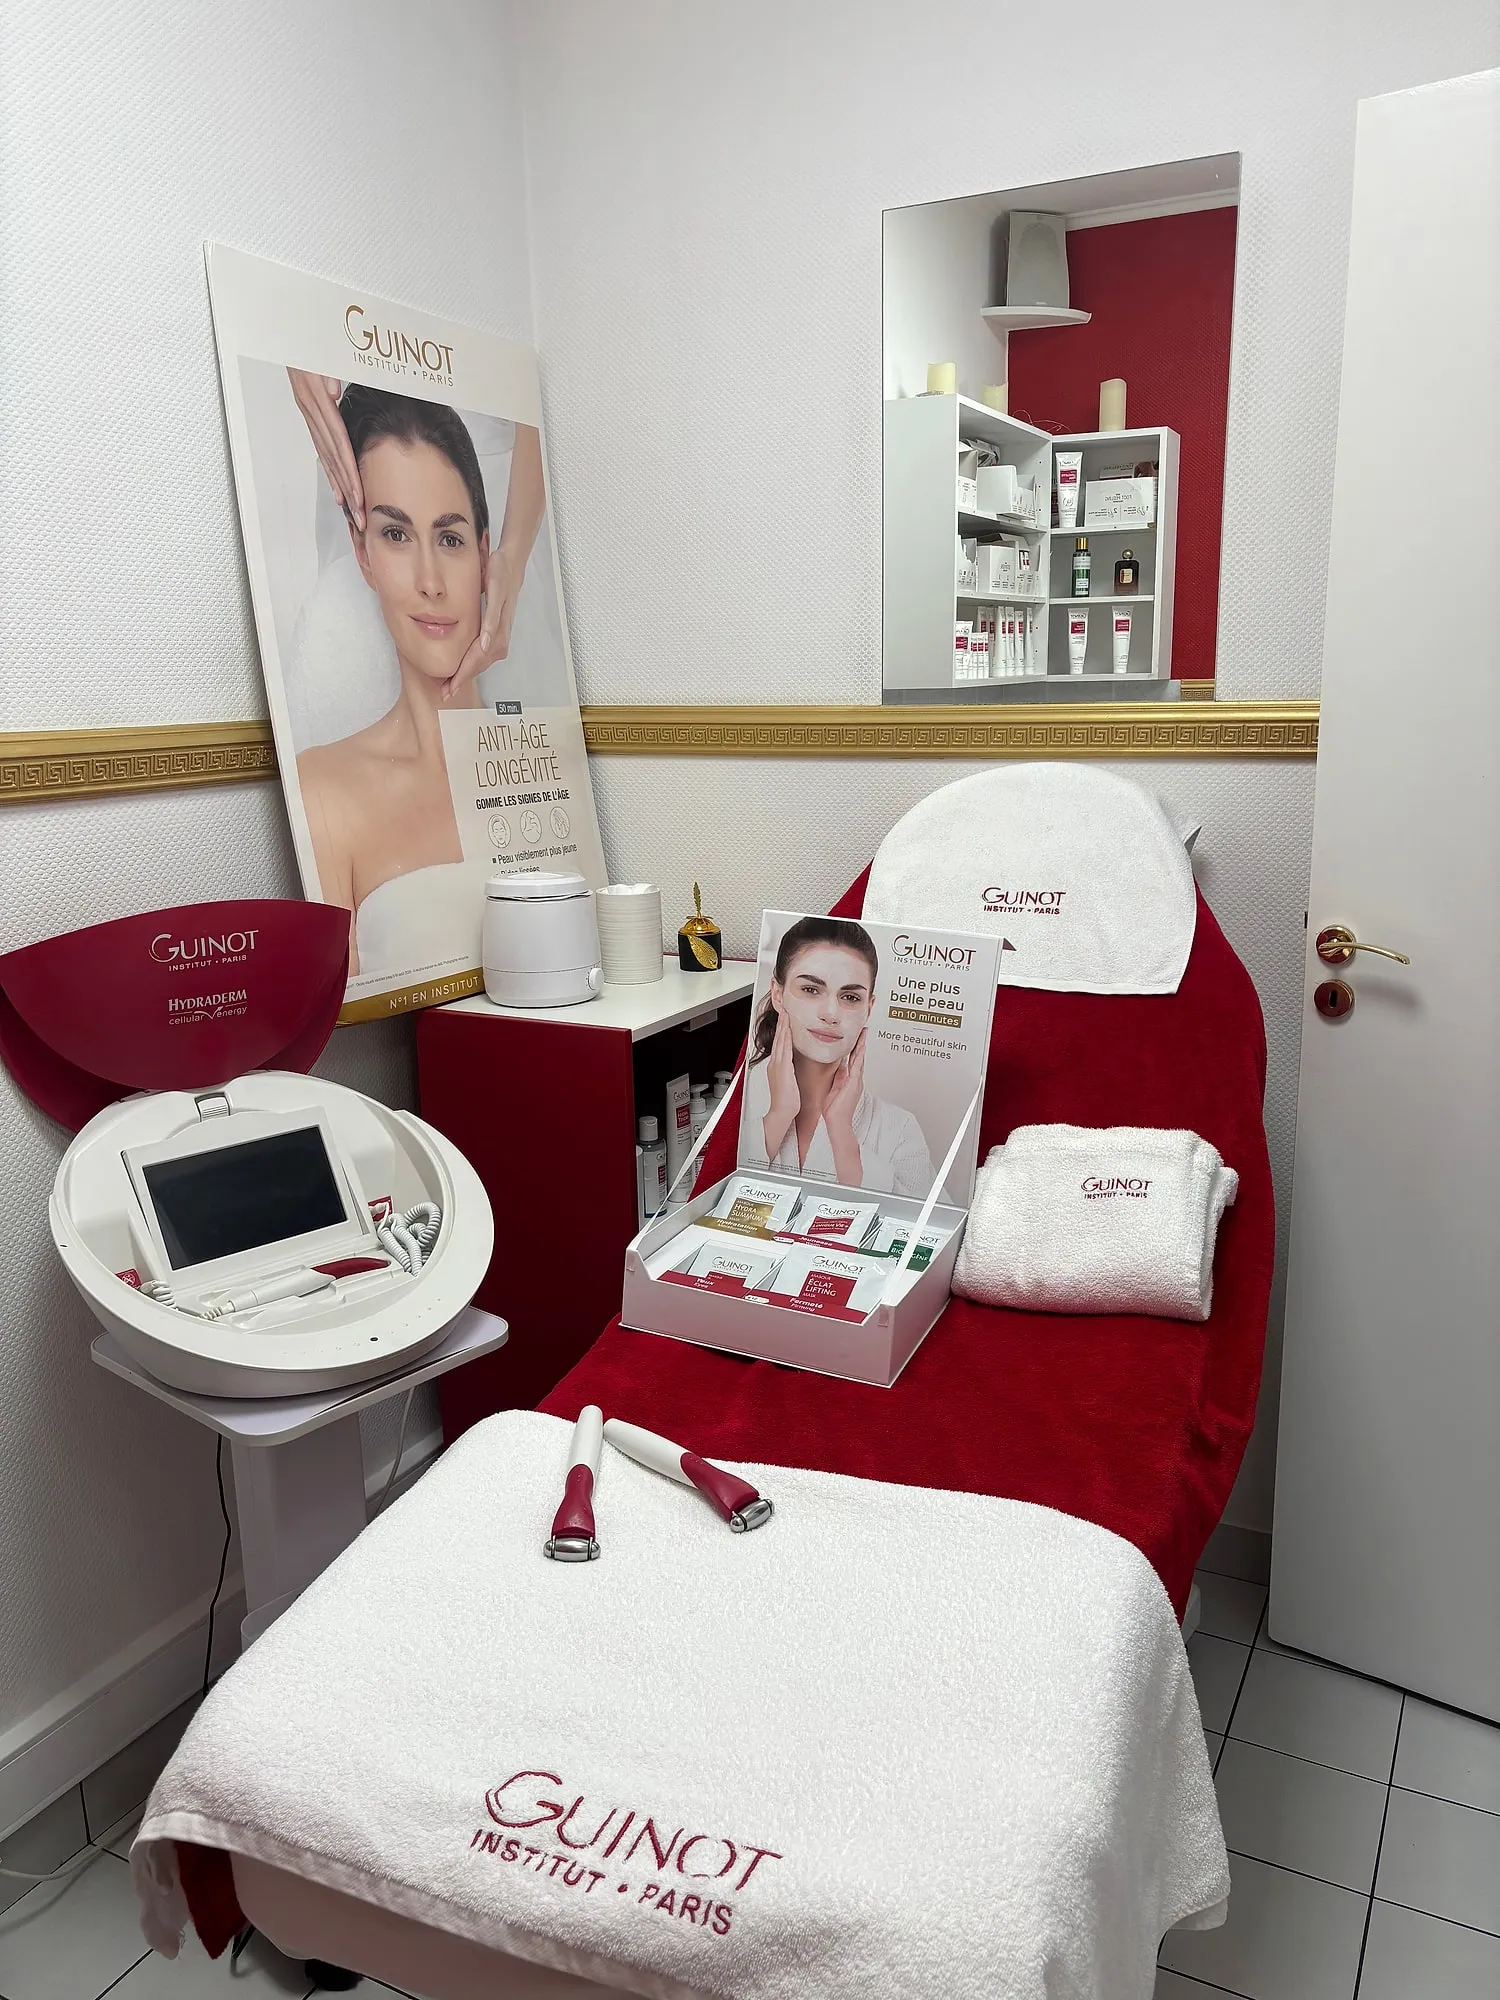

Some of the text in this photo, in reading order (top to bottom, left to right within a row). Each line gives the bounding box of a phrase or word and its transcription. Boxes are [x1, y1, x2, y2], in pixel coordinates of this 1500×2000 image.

[343, 304, 454, 375] GUINOT
[353, 351, 454, 387] INSTITUT PARIS
[498, 703, 520, 714] 50 min.
[477, 718, 550, 752] ANTI-ÂGE
[475, 750, 562, 788] LONGÉVITÉ
[475, 788, 570, 810] GOMME LES SIGNES DE L'ÂGE
[497, 843, 578, 864] Peau visiblement plus jeune
[981, 887, 1066, 906] GUINOT
[983, 904, 1061, 915] INSTITUT PARIS
[149, 929, 260, 963] GUINOT
[891, 934, 977, 965] GUINOT
[168, 954, 248, 972] INSTITUT PARIS
[893, 956, 971, 972] INSTITUT PARIS
[389, 976, 480, 1009] N°1 EN INSTITUT
[898, 975, 961, 995] Une plus
[168, 989, 248, 1012] HYDRADERM
[890, 990, 965, 1012] belle peau
[168, 1006, 248, 1025] cellular energy
[891, 1010, 960, 1027] en 10 minutes
[877, 1030, 968, 1052] More beautiful skin
[890, 1043, 952, 1060] in 10 minutes
[739, 1184, 783, 1200] GUINOT
[1080, 1176, 1153, 1192] GUINOT
[1084, 1191, 1148, 1200] INSTITUT PARIS
[731, 1209, 764, 1222] SUMMUM
[733, 1203, 757, 1213] HYDRA
[817, 1203, 862, 1216] GUINOT
[711, 1256, 754, 1272] GUINOT
[811, 1255, 866, 1273] GUINOT
[805, 1285, 837, 1297] LIFTING
[807, 1278, 834, 1289] ÉCLAT
[484, 1769, 784, 1892] GUINOT
[469, 1828, 735, 1936] INSTITUT PARIS
